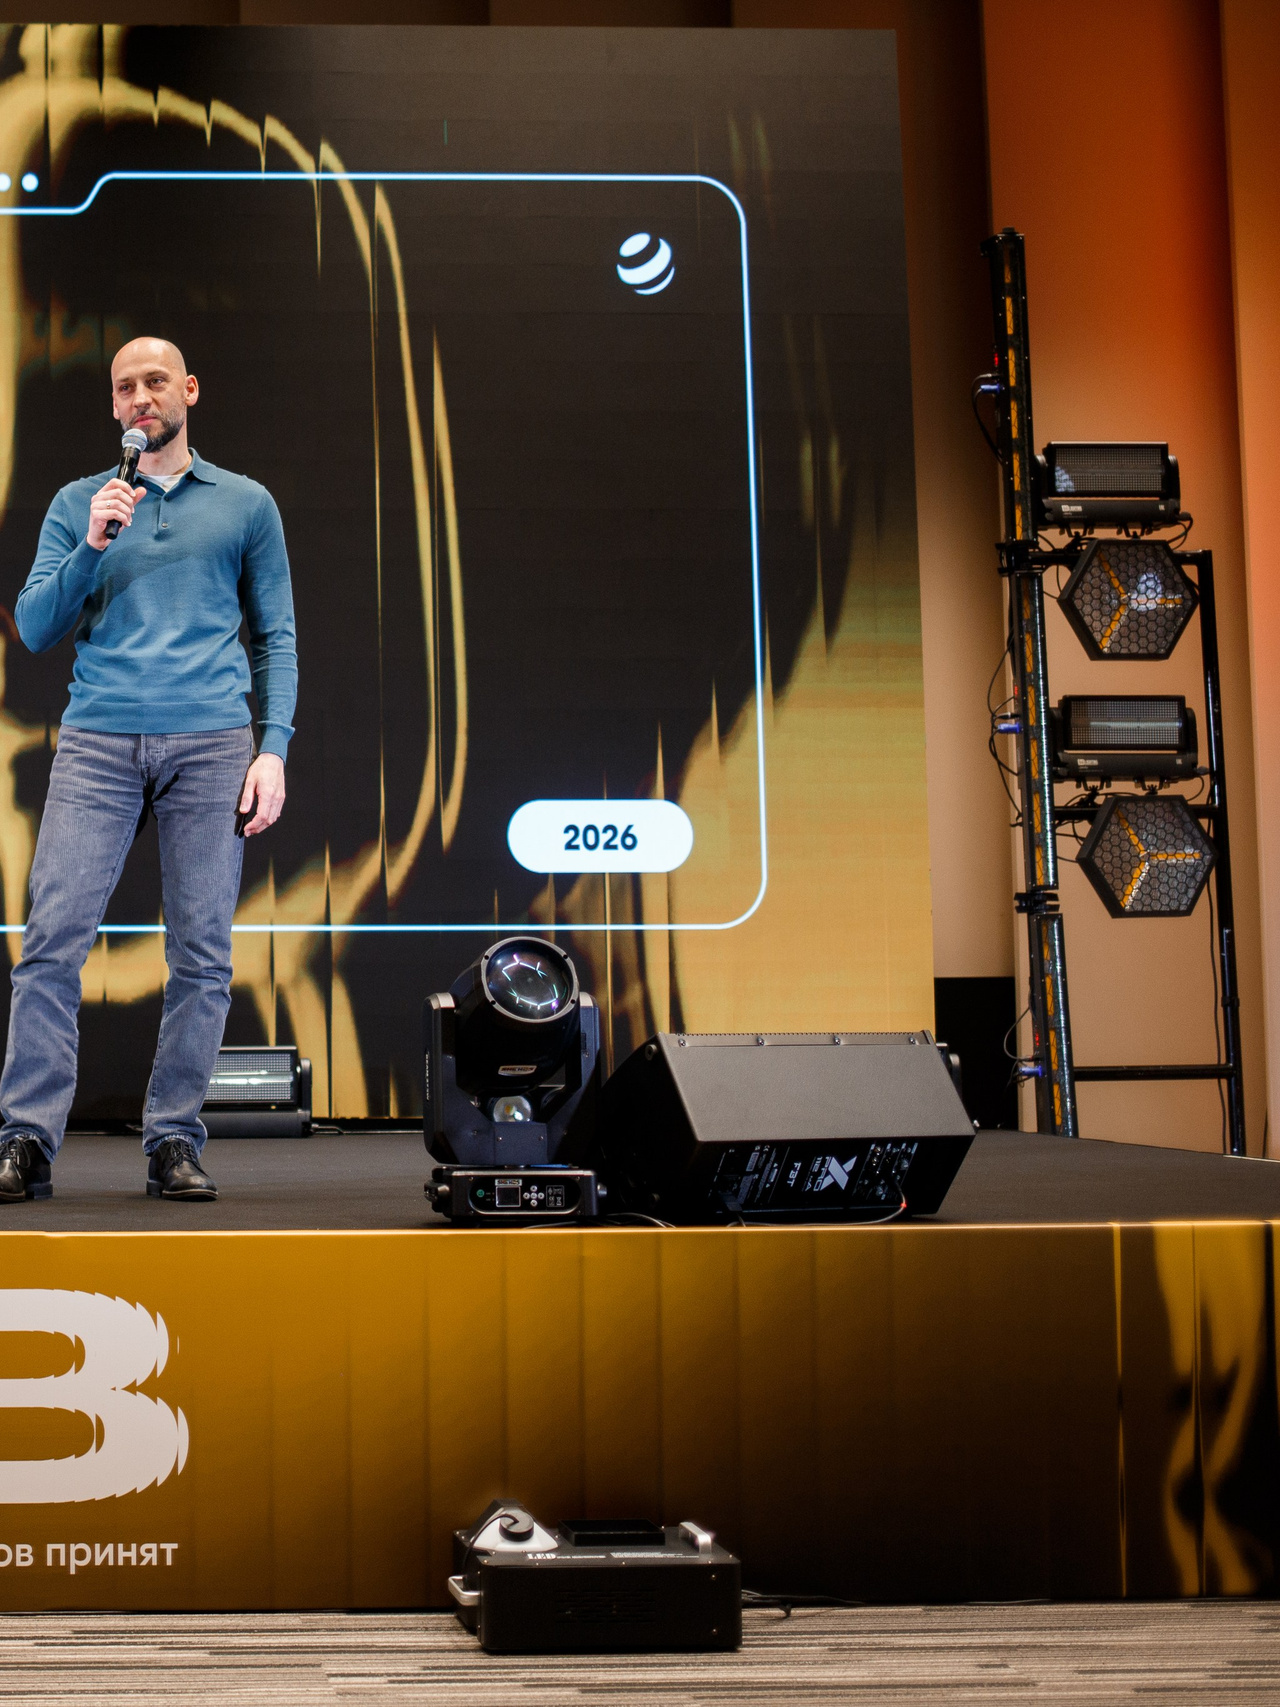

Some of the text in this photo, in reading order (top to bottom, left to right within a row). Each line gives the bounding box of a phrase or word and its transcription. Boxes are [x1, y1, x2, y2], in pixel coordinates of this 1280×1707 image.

[563, 823, 638, 851] 2026
[787, 1161, 802, 1188] FBT
[813, 1156, 832, 1192] PRO
[46, 1542, 179, 1575] принят
